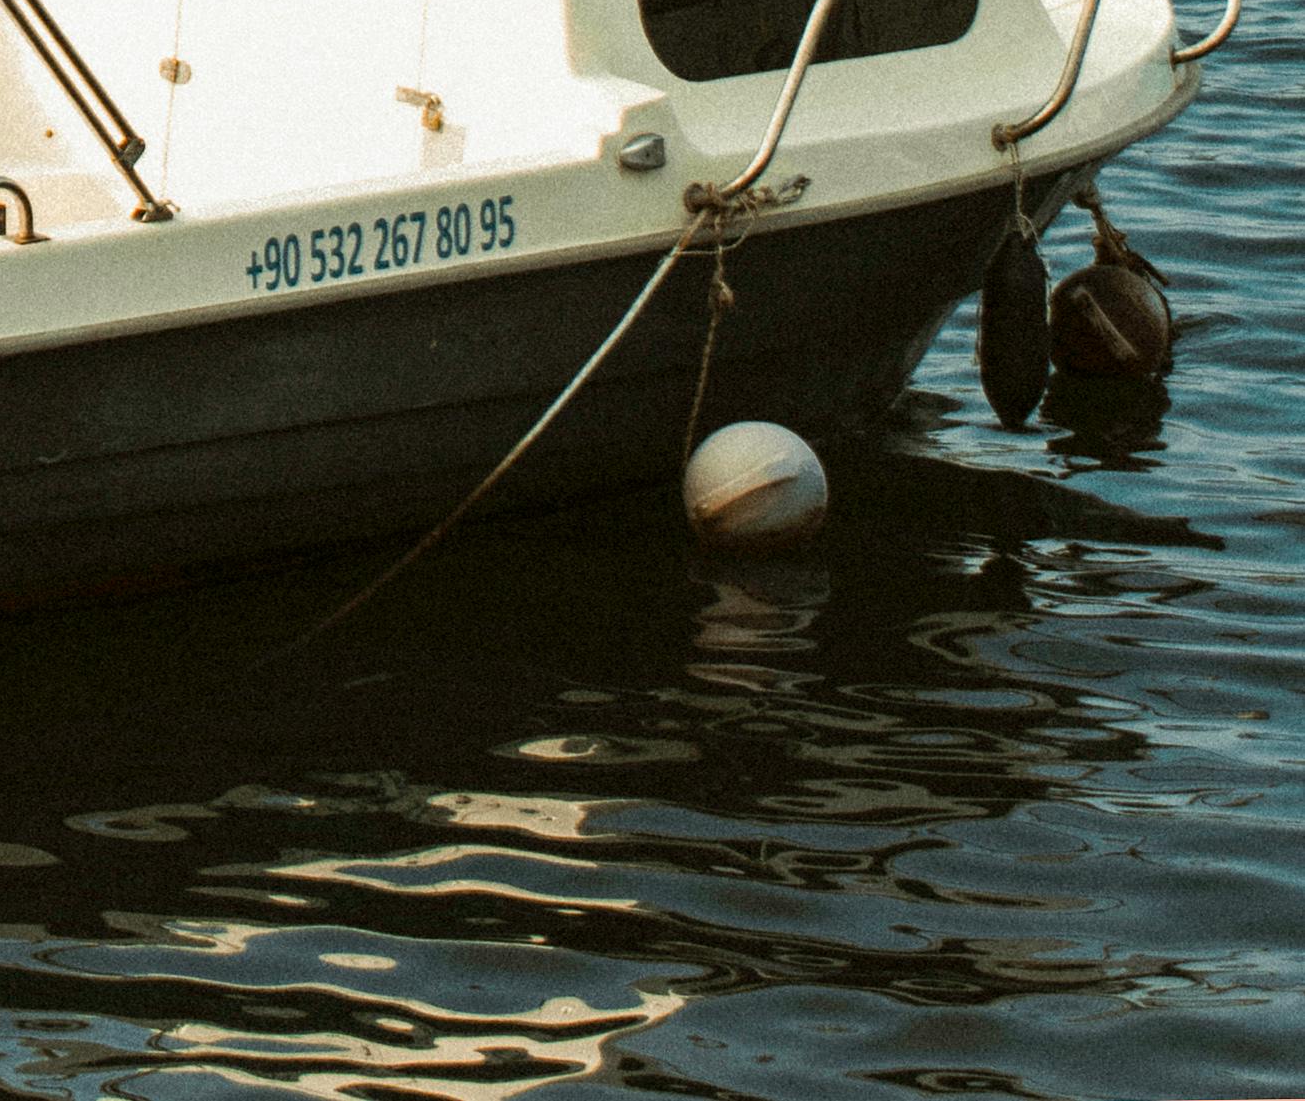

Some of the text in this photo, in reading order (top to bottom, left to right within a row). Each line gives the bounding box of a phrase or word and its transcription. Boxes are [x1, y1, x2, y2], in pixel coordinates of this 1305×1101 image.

[246, 195, 515, 291] +90 532 267 80 95
